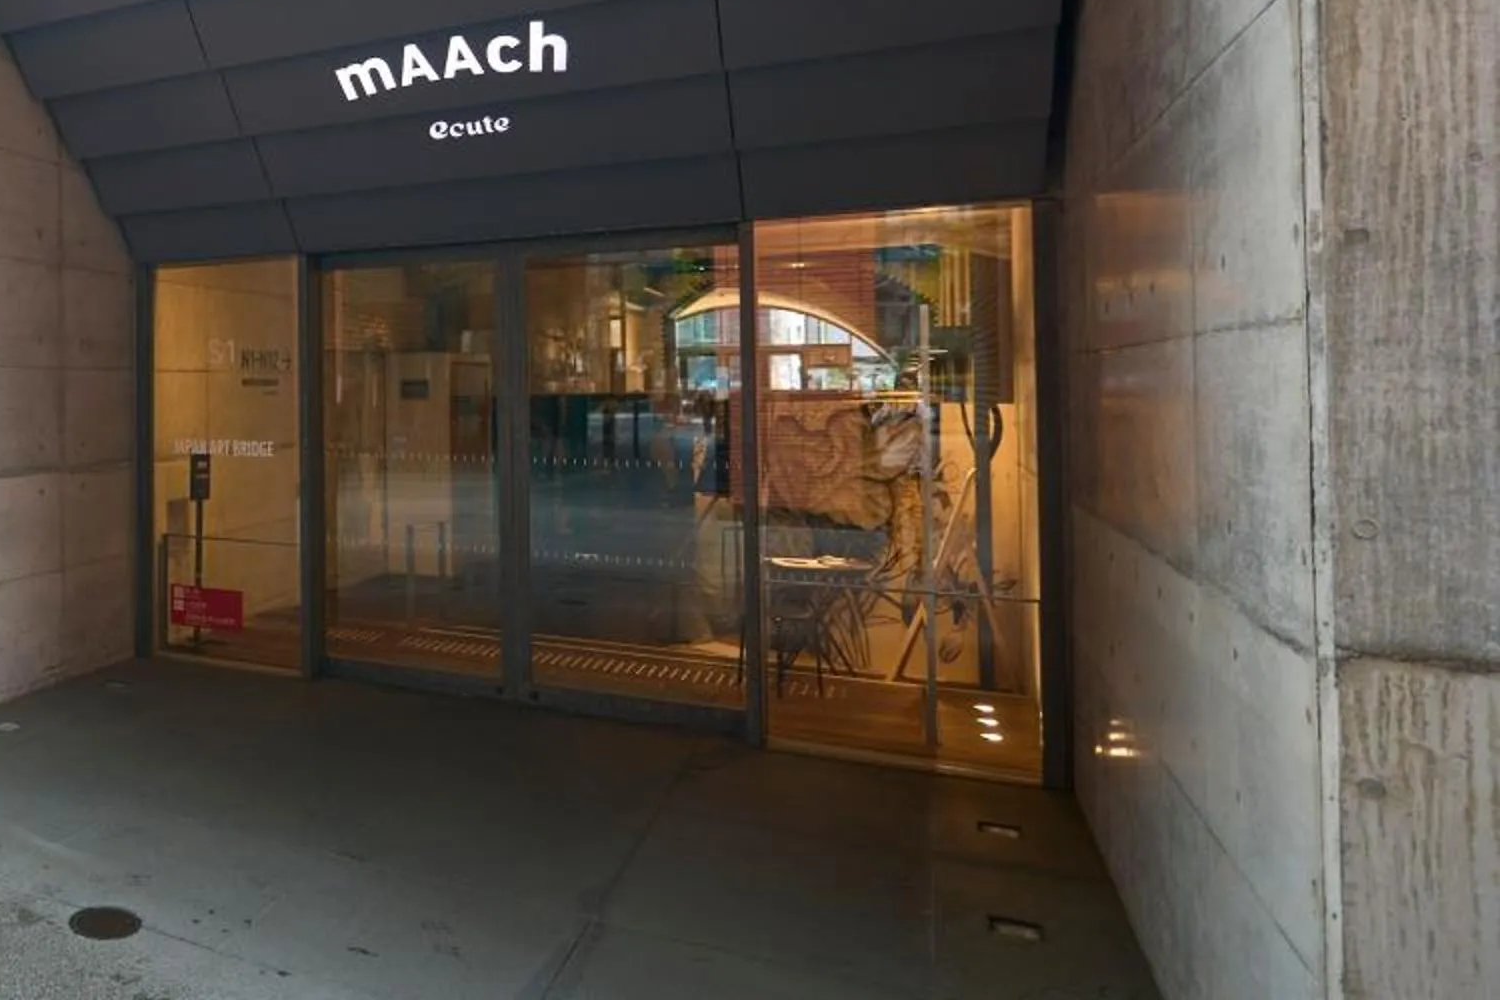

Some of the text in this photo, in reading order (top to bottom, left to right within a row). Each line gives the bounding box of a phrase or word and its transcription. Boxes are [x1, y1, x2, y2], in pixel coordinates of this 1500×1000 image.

[335, 20, 568, 101] mAAch
[429, 115, 511, 140] ecute
[233, 439, 275, 457] BRIDGE
